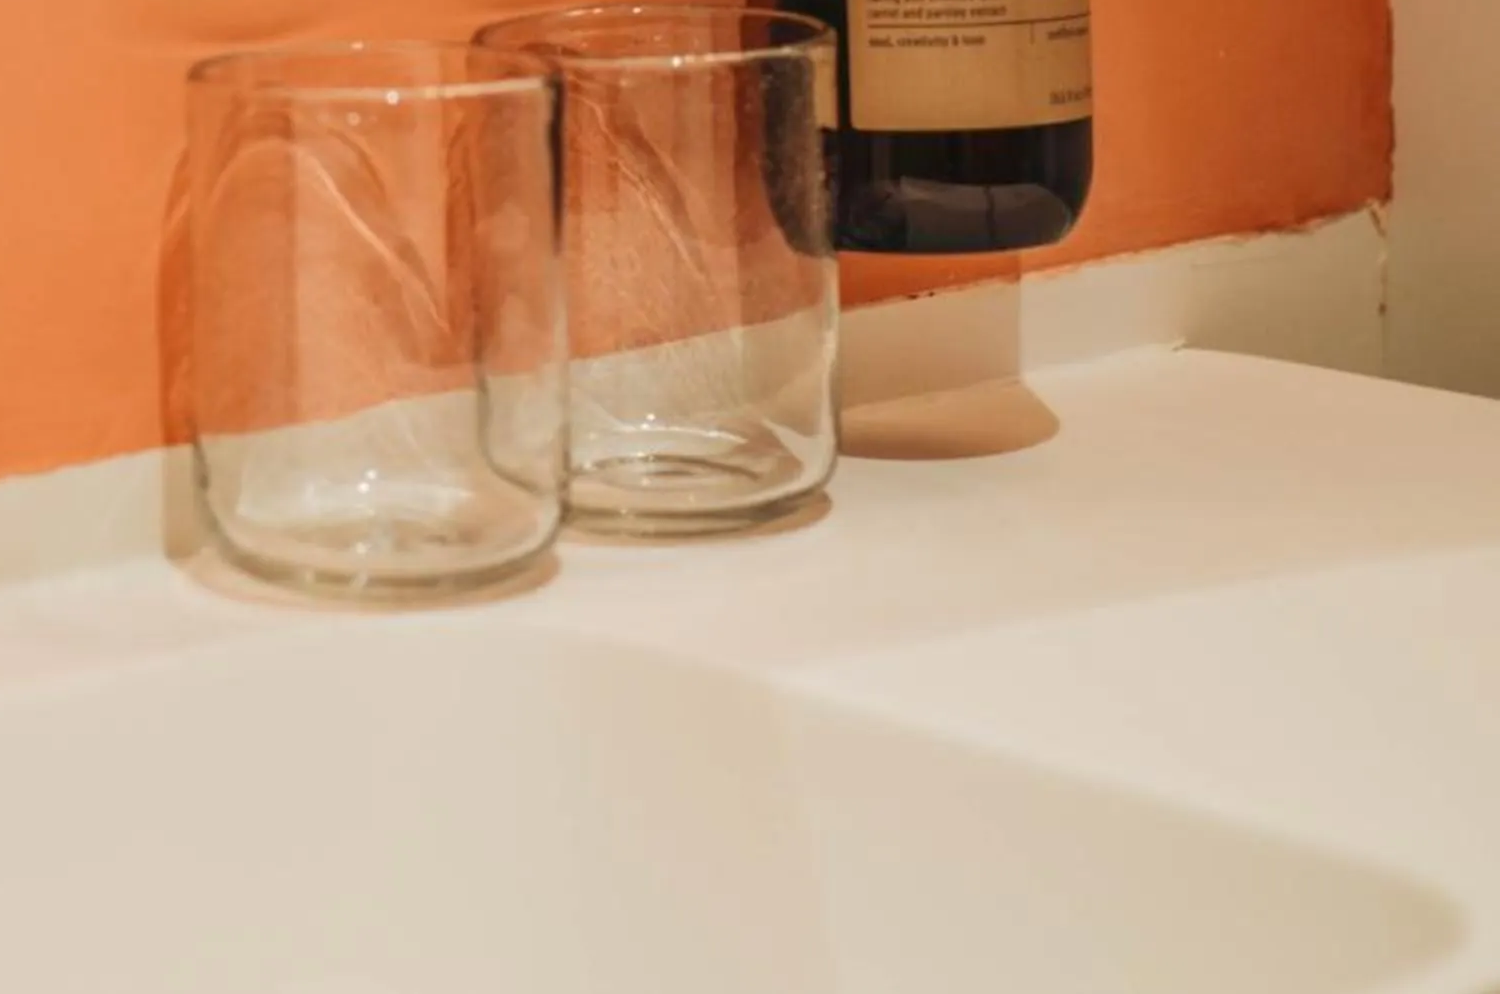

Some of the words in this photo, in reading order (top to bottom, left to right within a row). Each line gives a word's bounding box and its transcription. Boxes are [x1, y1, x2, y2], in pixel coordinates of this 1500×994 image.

[903, 6, 923, 19] and
[969, 5, 1007, 17] extract
[896, 34, 948, 48] creativity
